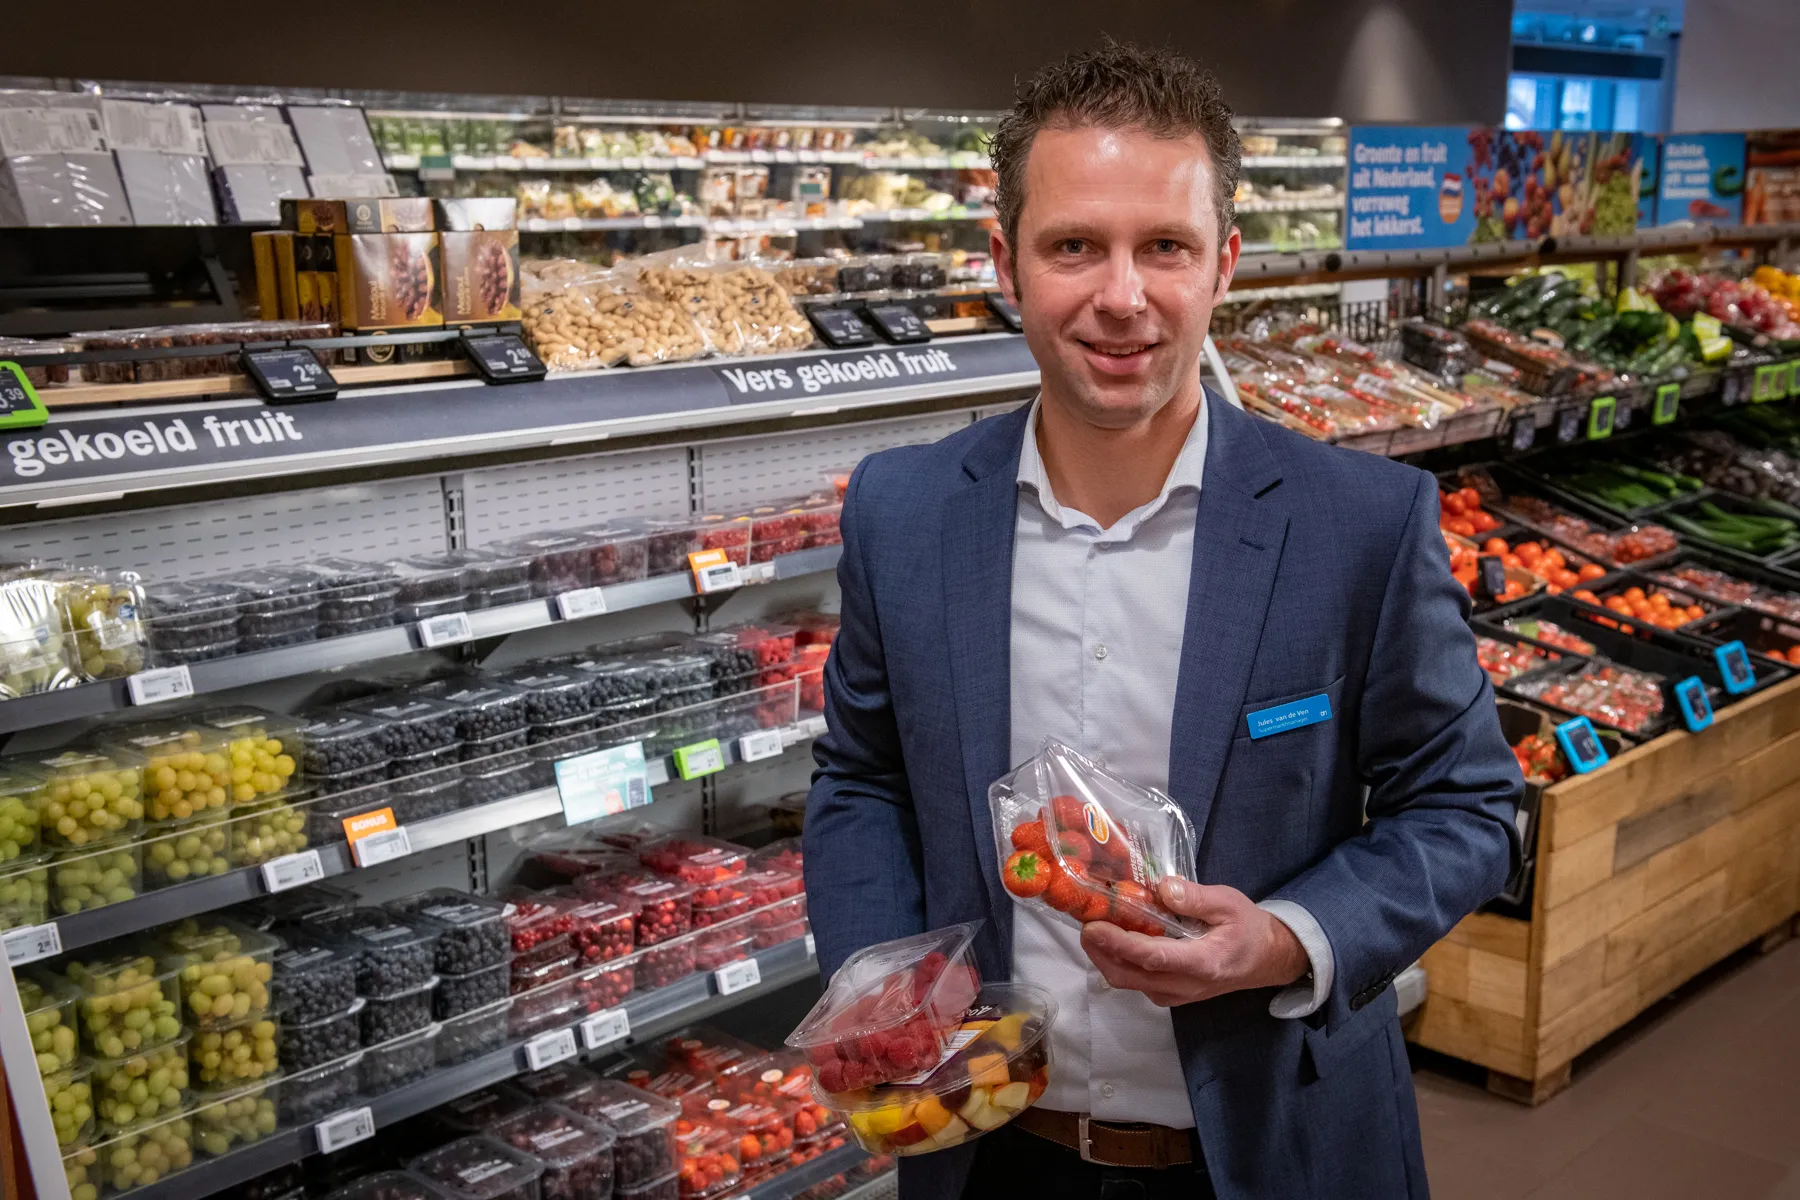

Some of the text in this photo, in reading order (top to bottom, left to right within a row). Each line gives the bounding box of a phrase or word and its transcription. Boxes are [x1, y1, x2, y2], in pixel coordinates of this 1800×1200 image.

[1355, 142, 1447, 164] Groente en fruit
[1353, 166, 1436, 189] uit Nederland,
[1351, 216, 1371, 237] het
[722, 349, 957, 394] Vers gekoeld fruit
[7, 411, 303, 477] gekoeld fruit
[1258, 718, 1273, 727] Jules
